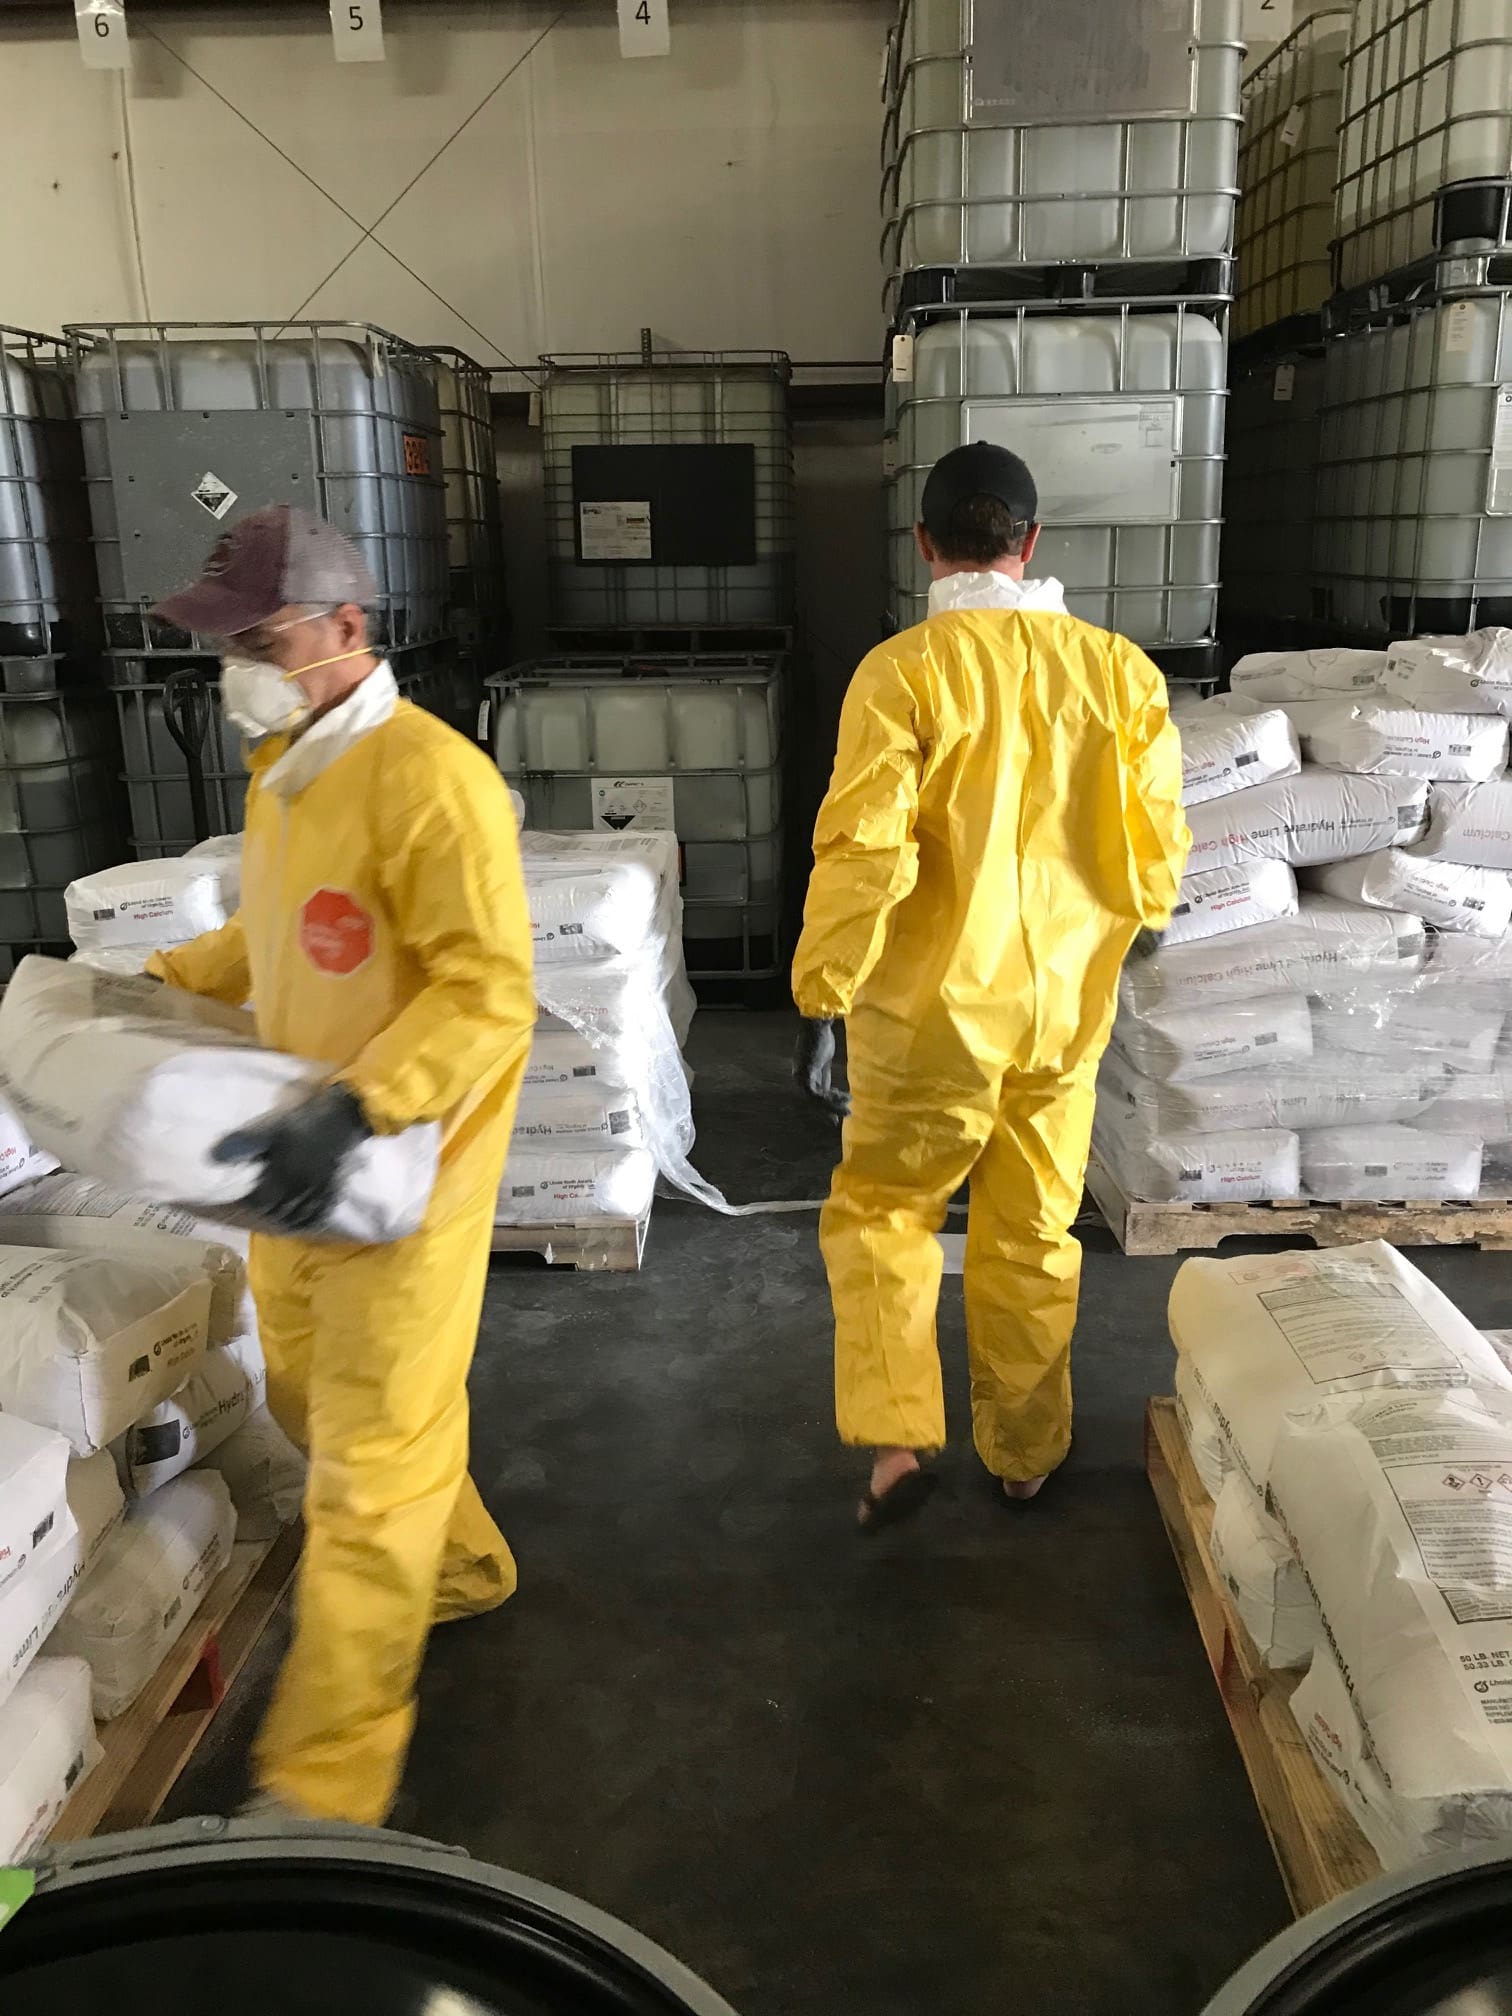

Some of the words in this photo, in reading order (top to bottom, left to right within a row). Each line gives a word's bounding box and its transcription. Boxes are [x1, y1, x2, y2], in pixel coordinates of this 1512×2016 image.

[95, 13, 109, 37] 6
[349, 6, 363, 30] 5
[635, 1, 651, 25] 4
[1250, 828, 1280, 840] Lime
[133, 913, 148, 921] High
[149, 910, 174, 919] Calcium
[13, 1625, 39, 1668] Lime
[1460, 1655, 1472, 1663] 50
[1491, 1650, 1510, 1659] NET
